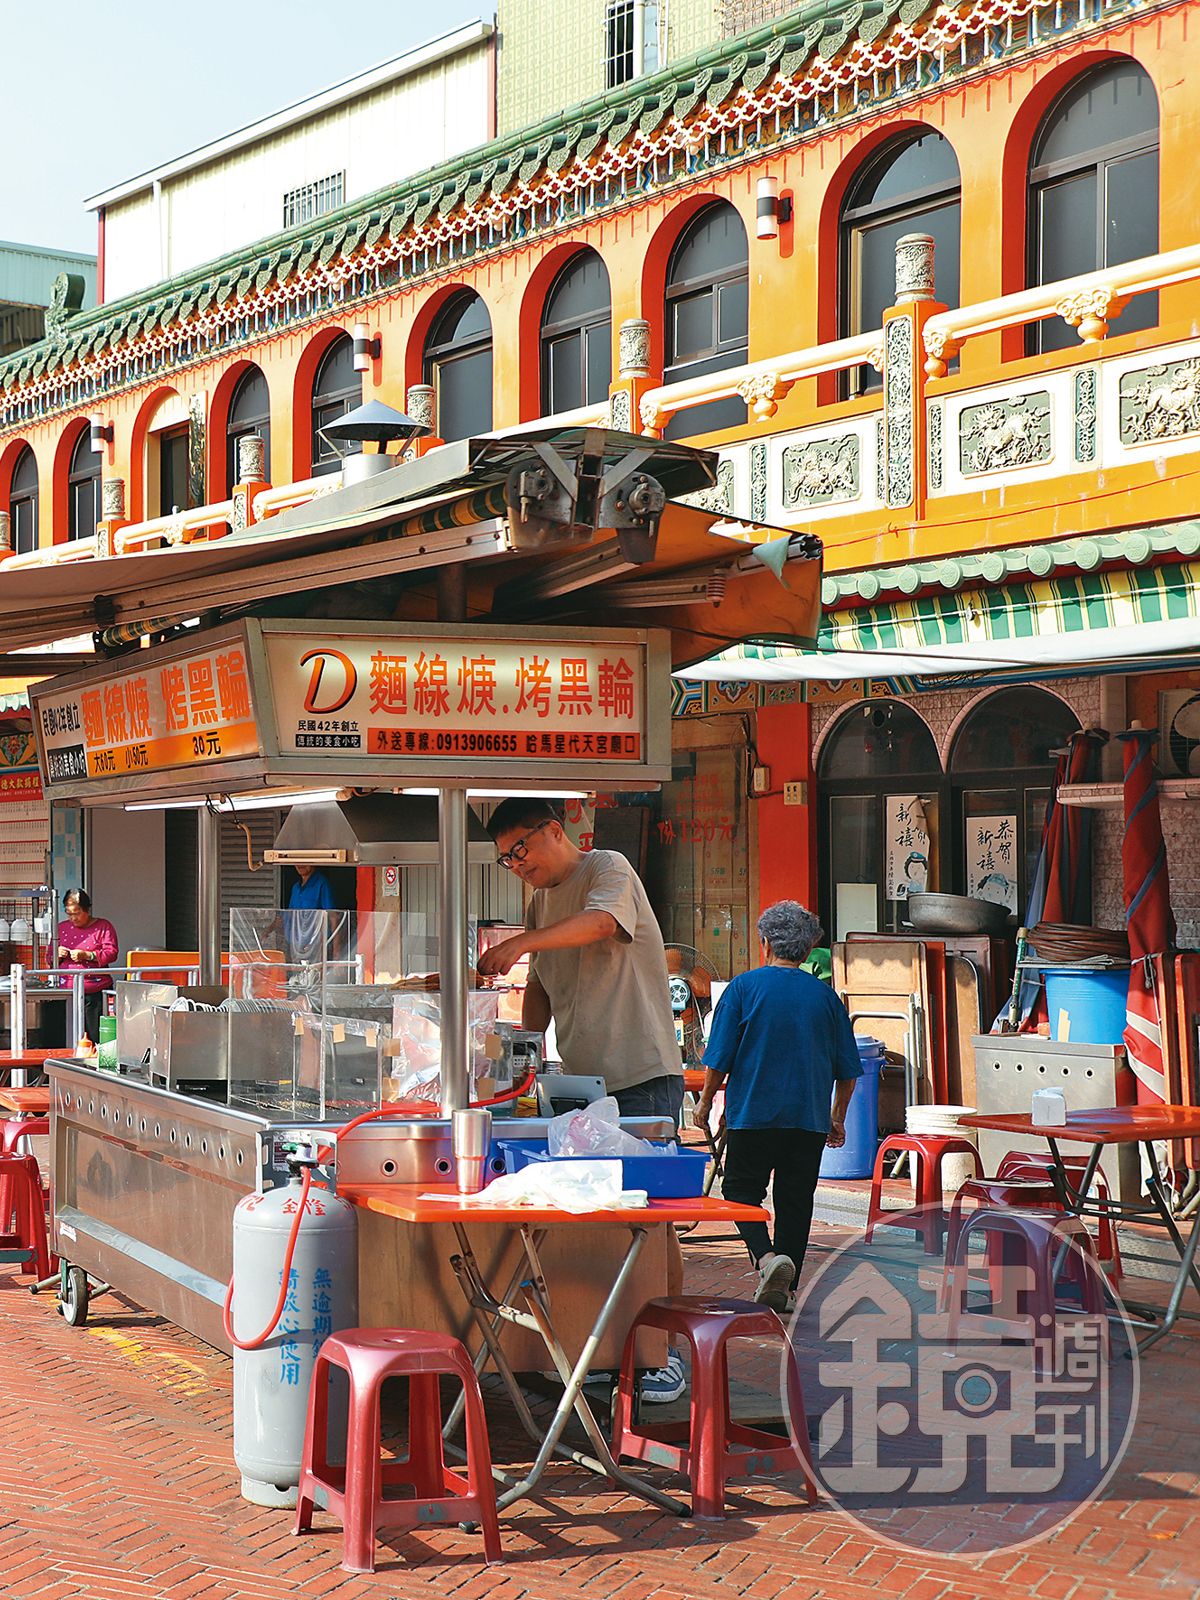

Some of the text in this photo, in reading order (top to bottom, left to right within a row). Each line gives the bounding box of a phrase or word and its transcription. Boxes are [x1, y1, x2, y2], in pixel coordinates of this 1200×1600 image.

[160, 650, 251, 732] 烤黑輪
[300, 647, 358, 715] D
[297, 735, 360, 747] 傳統的美食小吃
[298, 719, 359, 732] 民國42年創立
[94, 731, 222, 773] 大60元 小50元 30元
[895, 803, 914, 847] 新禧
[994, 819, 1014, 865] 恭賀
[976, 826, 996, 871] 新禧
